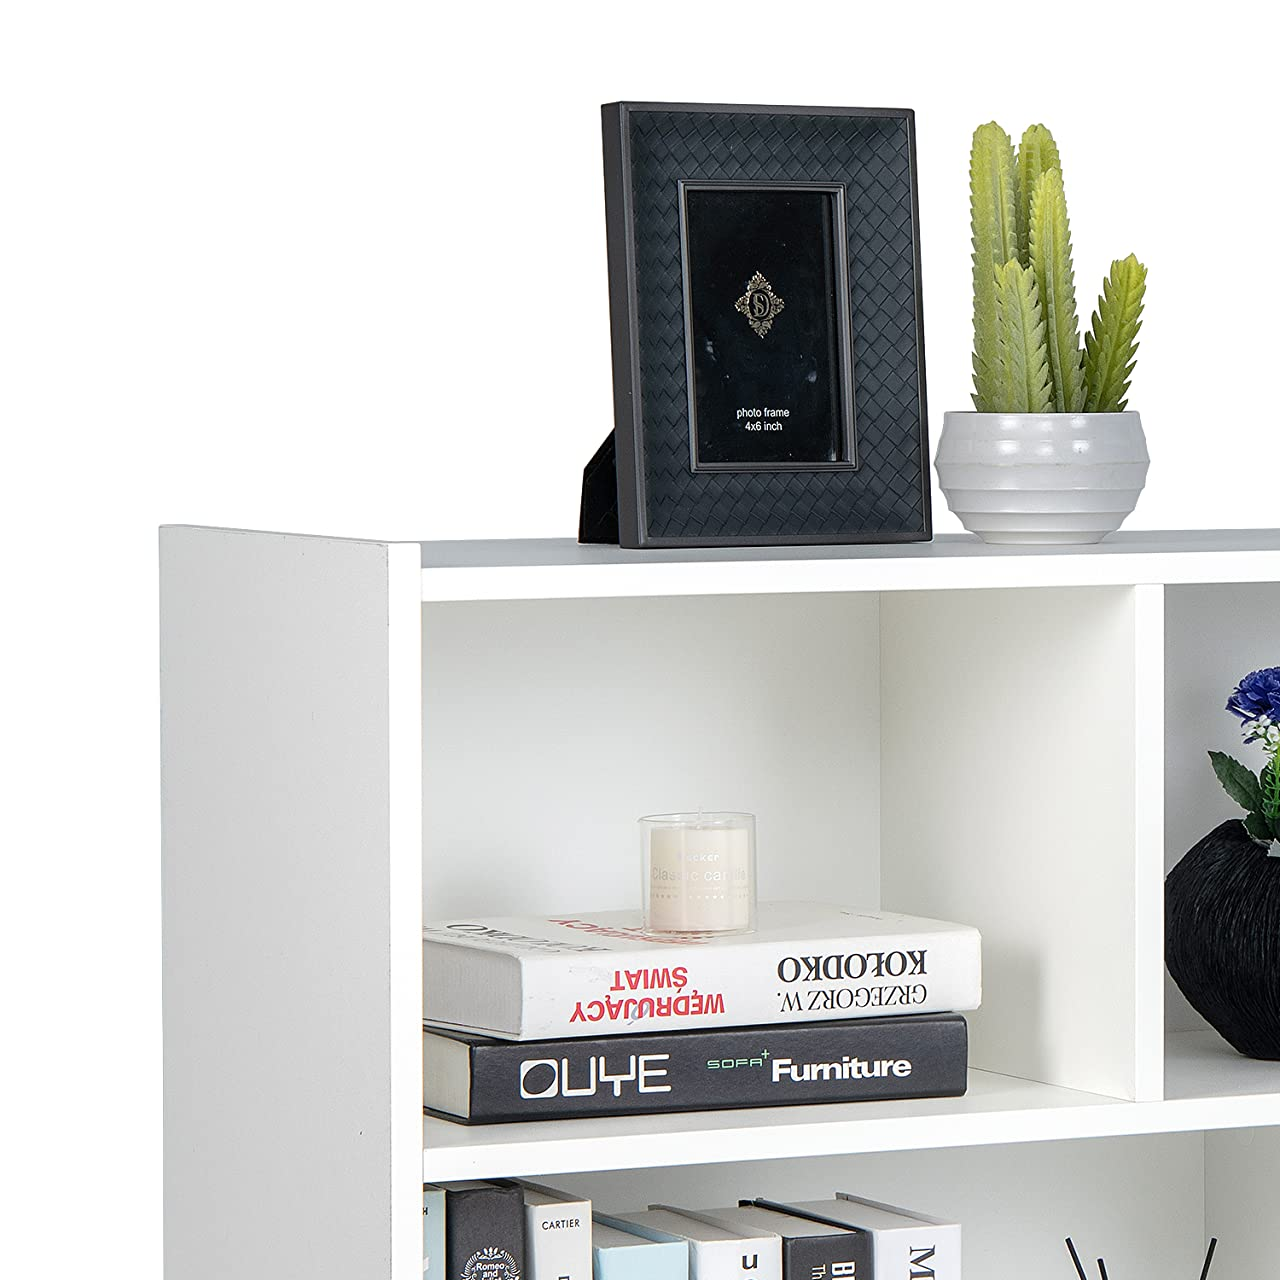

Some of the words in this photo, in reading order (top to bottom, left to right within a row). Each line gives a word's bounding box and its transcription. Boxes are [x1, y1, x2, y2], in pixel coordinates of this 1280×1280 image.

[737, 407, 762, 419] photo
[764, 407, 790, 417] frame
[745, 421, 762, 431] 4x6
[763, 421, 783, 431] inch
[652, 866, 698, 881] Clasic
[777, 949, 928, 983] KOŁODKO
[610, 966, 689, 994] ŚWIAT
[569, 989, 725, 1023] WĘDRUJĄCY
[777, 991, 801, 1013] W.
[807, 984, 927, 1011] GRZEGORZ
[771, 1056, 912, 1083] Furniture
[541, 1218, 580, 1230] CARTIER
[476, 1262, 505, 1271] Romeo
[482, 1270, 498, 1278] and
